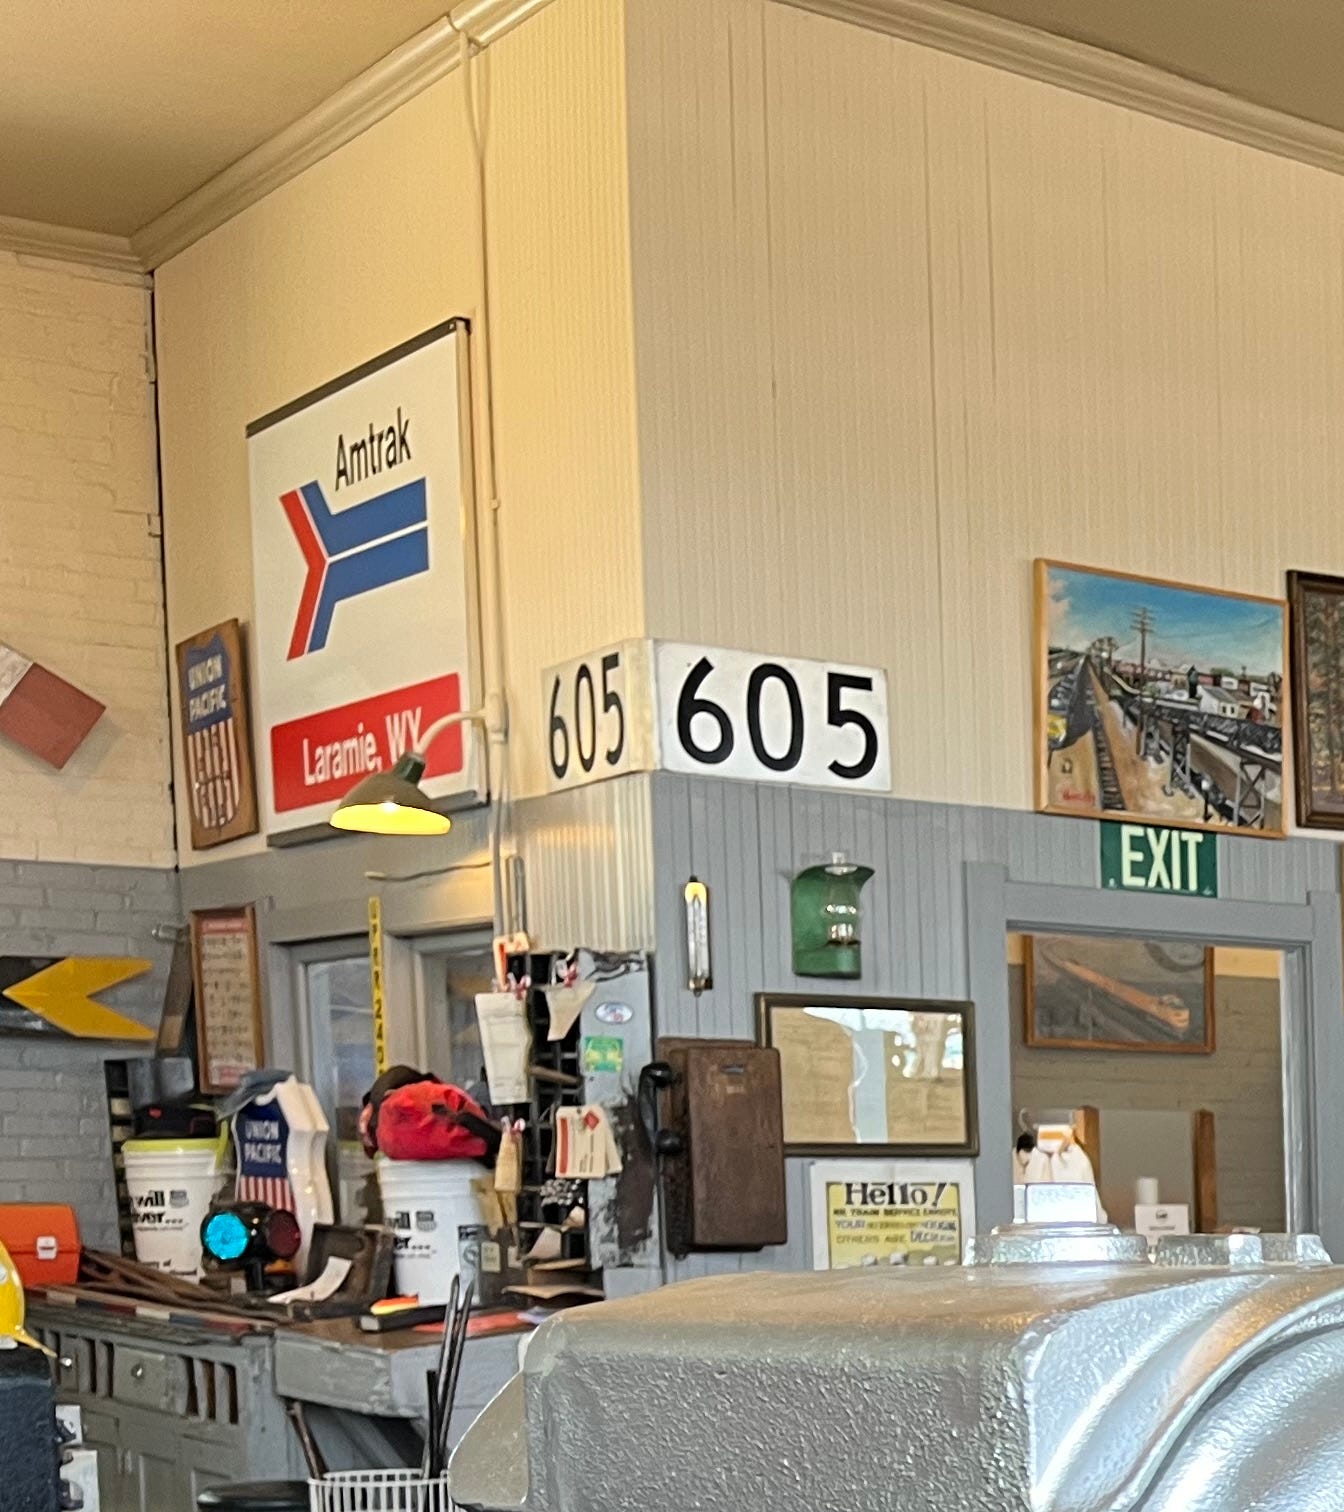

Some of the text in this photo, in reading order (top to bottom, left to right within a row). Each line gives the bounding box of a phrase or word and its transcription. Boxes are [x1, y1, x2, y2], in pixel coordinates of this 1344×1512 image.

[334, 406, 412, 491] Amtrak
[188, 653, 223, 690] UNION
[189, 684, 227, 722] PACIFIC
[548, 651, 626, 780] 605
[675, 656, 880, 780] 605
[303, 722, 382, 786] Laramie,
[1120, 824, 1204, 892] EXIT
[244, 1119, 280, 1141] UNION
[244, 1143, 282, 1165] PACIFIC
[845, 1182, 948, 1207] Hello!
